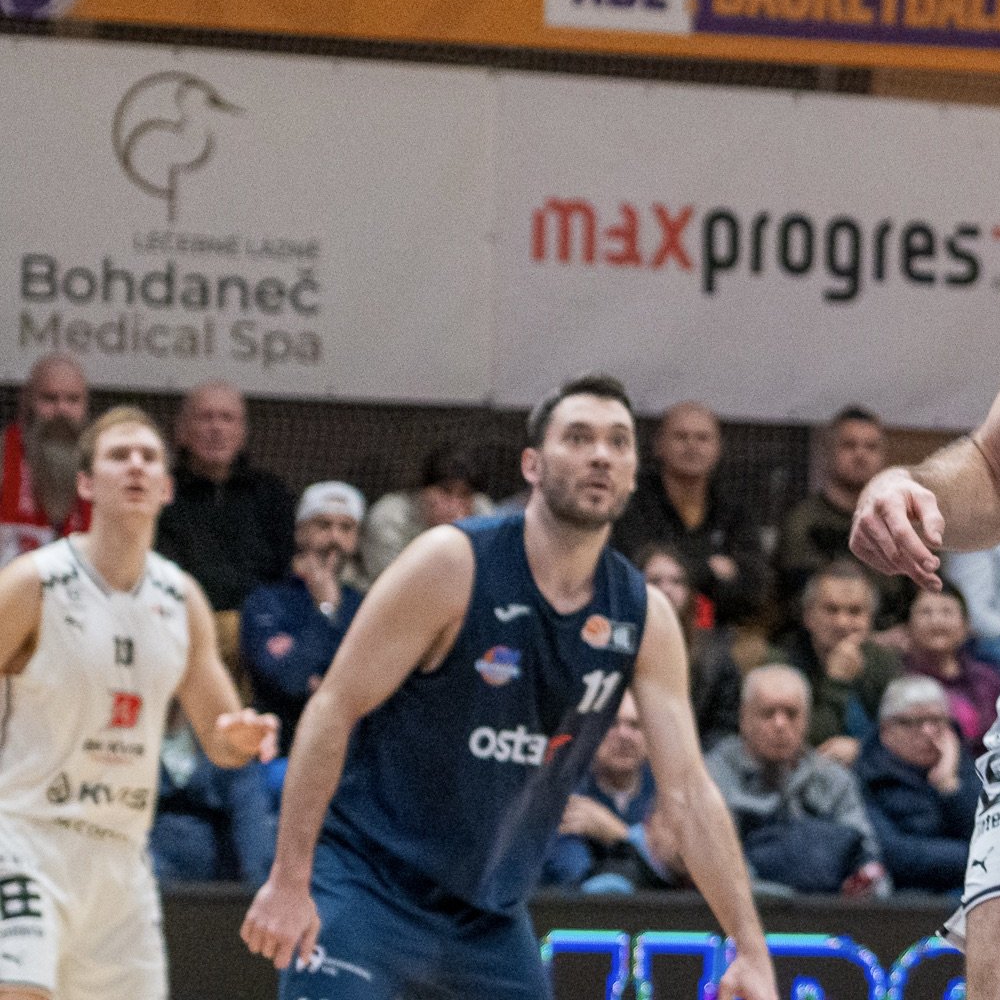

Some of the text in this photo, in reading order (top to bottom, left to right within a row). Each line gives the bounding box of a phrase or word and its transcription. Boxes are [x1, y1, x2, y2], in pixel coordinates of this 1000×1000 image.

[19, 252, 321, 317] Bohdaneč
[18, 309, 325, 370] Medical Spa
[576, 669, 622, 714] 11
